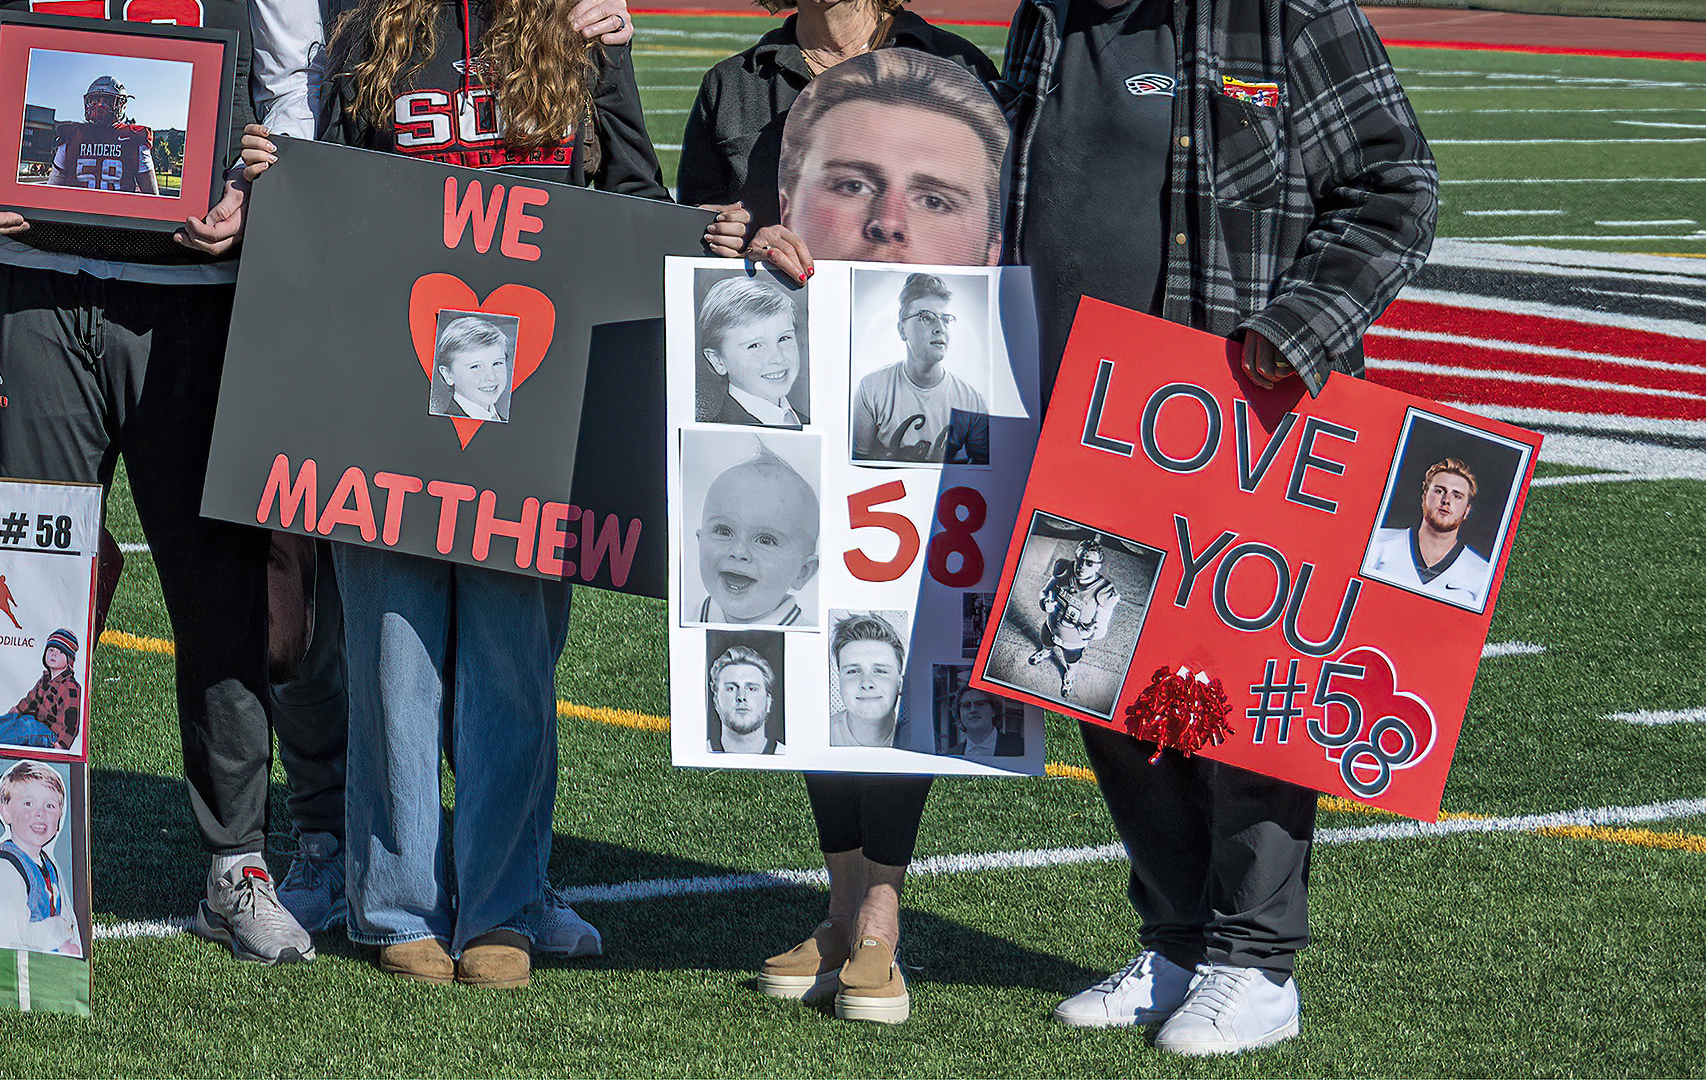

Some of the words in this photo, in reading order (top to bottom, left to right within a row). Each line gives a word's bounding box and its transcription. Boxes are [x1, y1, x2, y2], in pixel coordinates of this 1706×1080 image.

[80, 143, 122, 158] RAIDERS
[443, 176, 550, 262] WE
[1080, 359, 1358, 514] LOVE
[255, 453, 643, 587] MATTHEW
[843, 479, 988, 588] 58
[1173, 513, 1362, 657] YOU
[1245, 658, 1415, 798] #58
